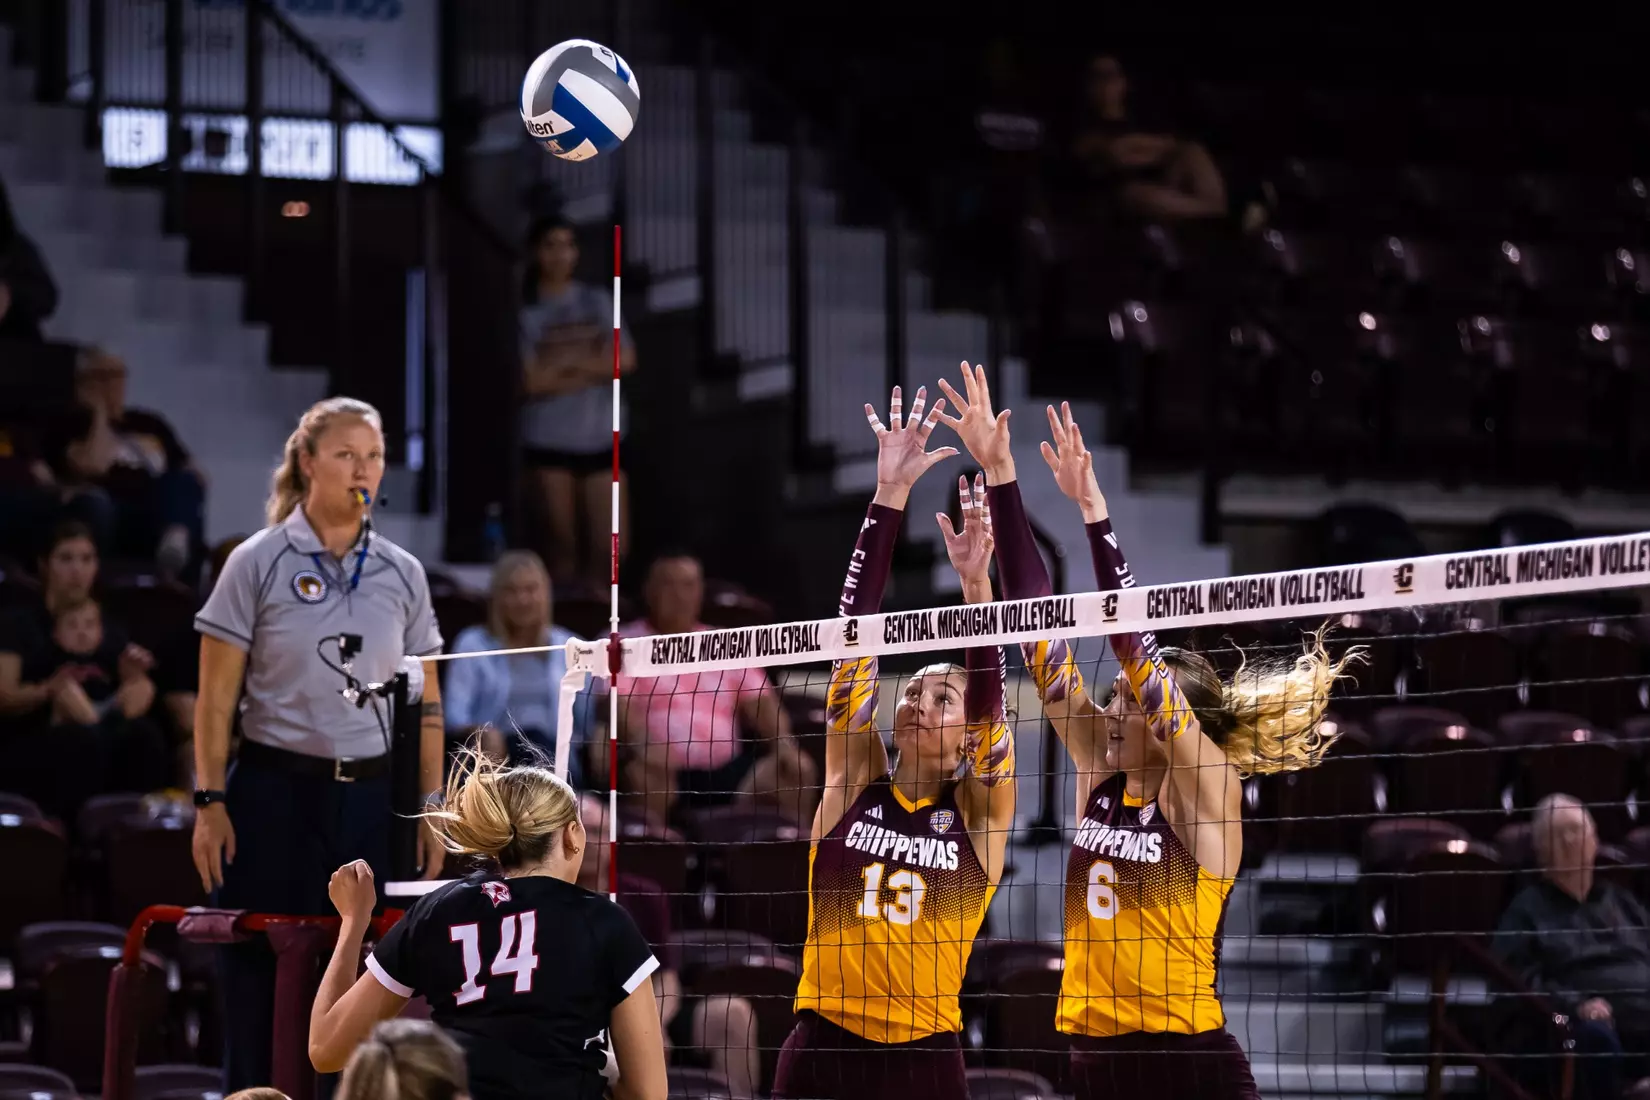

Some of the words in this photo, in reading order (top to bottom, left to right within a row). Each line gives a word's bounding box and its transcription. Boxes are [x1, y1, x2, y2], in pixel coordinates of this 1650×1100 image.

[525, 119, 554, 135] lten
[1445, 553, 1511, 590] CENTRAL
[1516, 545, 1594, 584] MICHIGAN
[1599, 538, 1650, 576] VOLLE
[1146, 584, 1205, 619] CENTRAL
[1209, 577, 1275, 613] MICHIGAN
[1279, 568, 1365, 606] VOLLEYBALL
[651, 636, 695, 665] CENTRAL
[698, 630, 752, 663] MICHIGAN
[755, 623, 821, 657] VOLLEYBALL
[883, 611, 935, 644] CENTRAL
[937, 605, 998, 639] MICHIGAN
[1001, 598, 1076, 634] VOLLEYBALL
[845, 820, 959, 871] CHIPPEWAS
[855, 861, 928, 926] 13
[1086, 859, 1120, 921] 6
[447, 908, 541, 1008] 14
